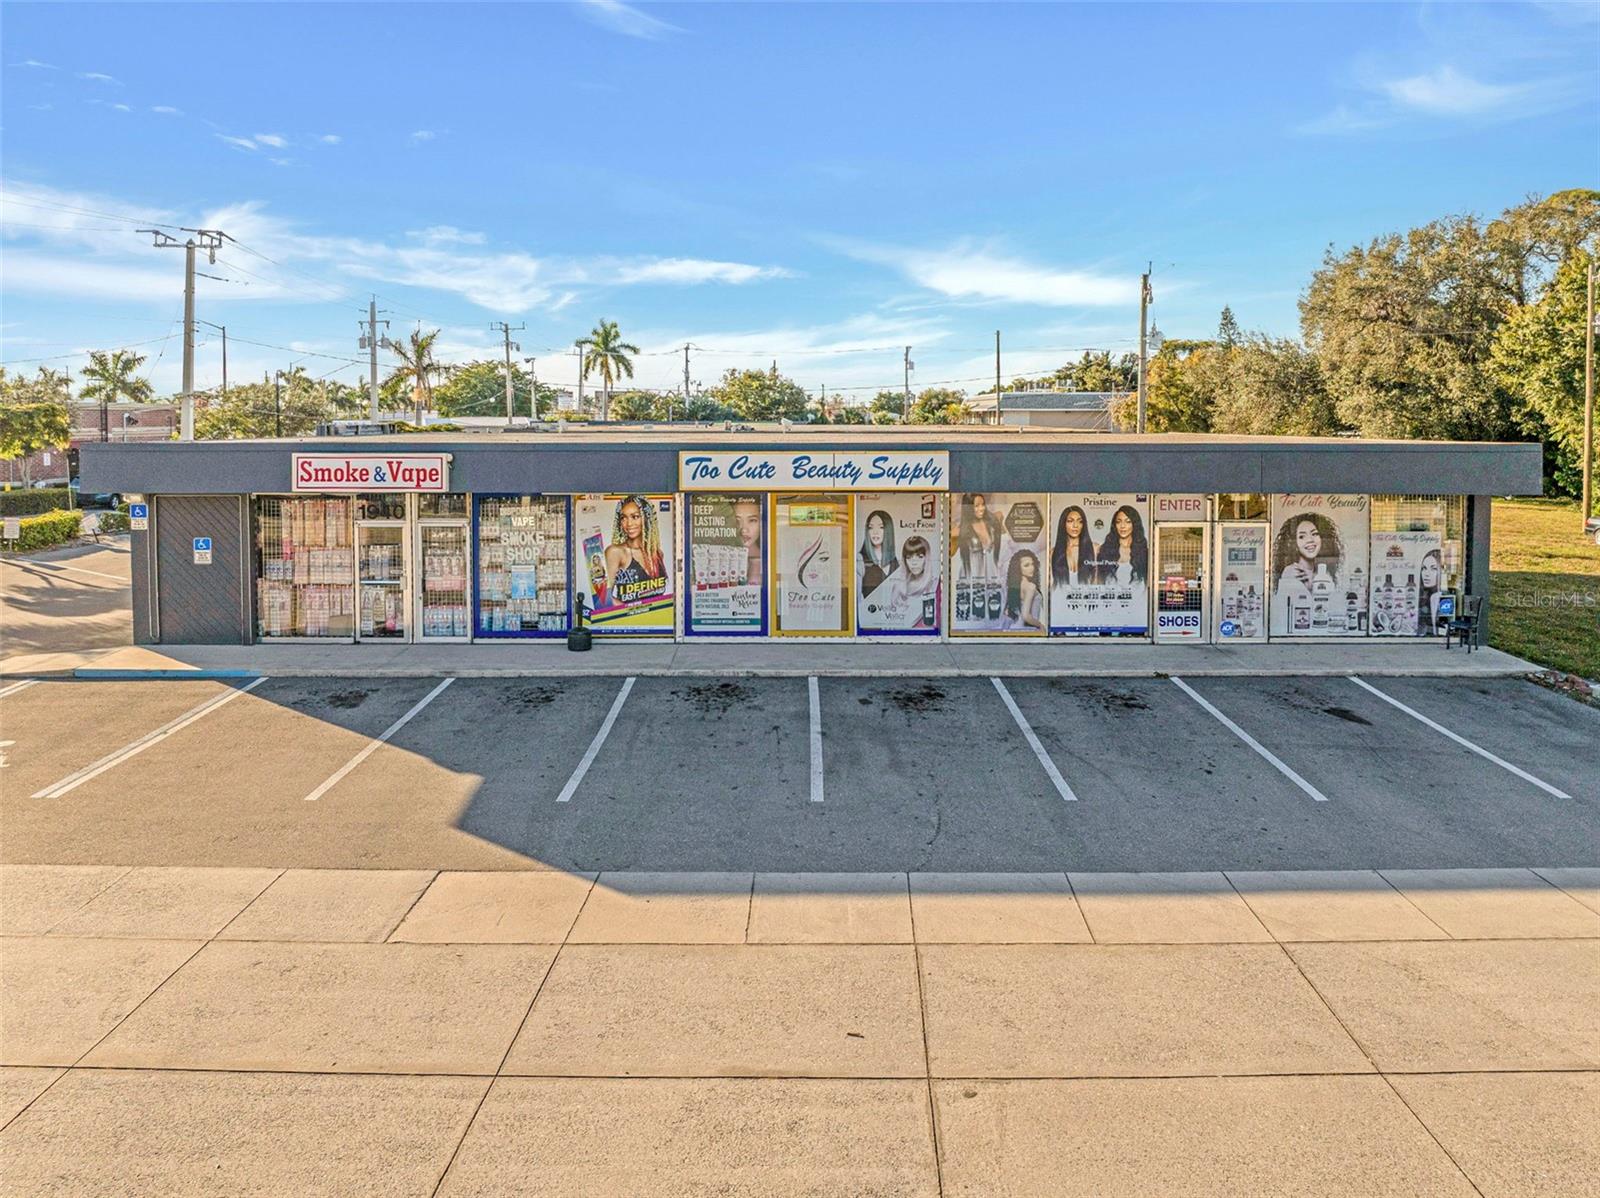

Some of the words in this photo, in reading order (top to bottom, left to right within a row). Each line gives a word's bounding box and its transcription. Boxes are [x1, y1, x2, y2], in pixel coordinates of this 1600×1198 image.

[300, 460, 369, 483] Smoke
[373, 466, 387, 483] &
[386, 461, 440, 488] Vape
[684, 456, 721, 481] Too
[728, 456, 776, 479] Cute
[791, 456, 863, 485] Beauty
[868, 456, 943, 486] Supply
[1083, 497, 1118, 506] Pristine
[1160, 499, 1201, 511] ENTER
[1327, 494, 1367, 512] Beauty
[358, 504, 405, 520] 1940
[694, 505, 713, 515] DEEP
[511, 516, 535, 527] VAPE
[694, 516, 725, 526] LASTING
[500, 531, 545, 546] SMOKE
[694, 527, 737, 538] HYDRATION
[506, 547, 540, 562] SHOP
[626, 577, 665, 594] DEFINE
[1158, 616, 1199, 627] SHOES
